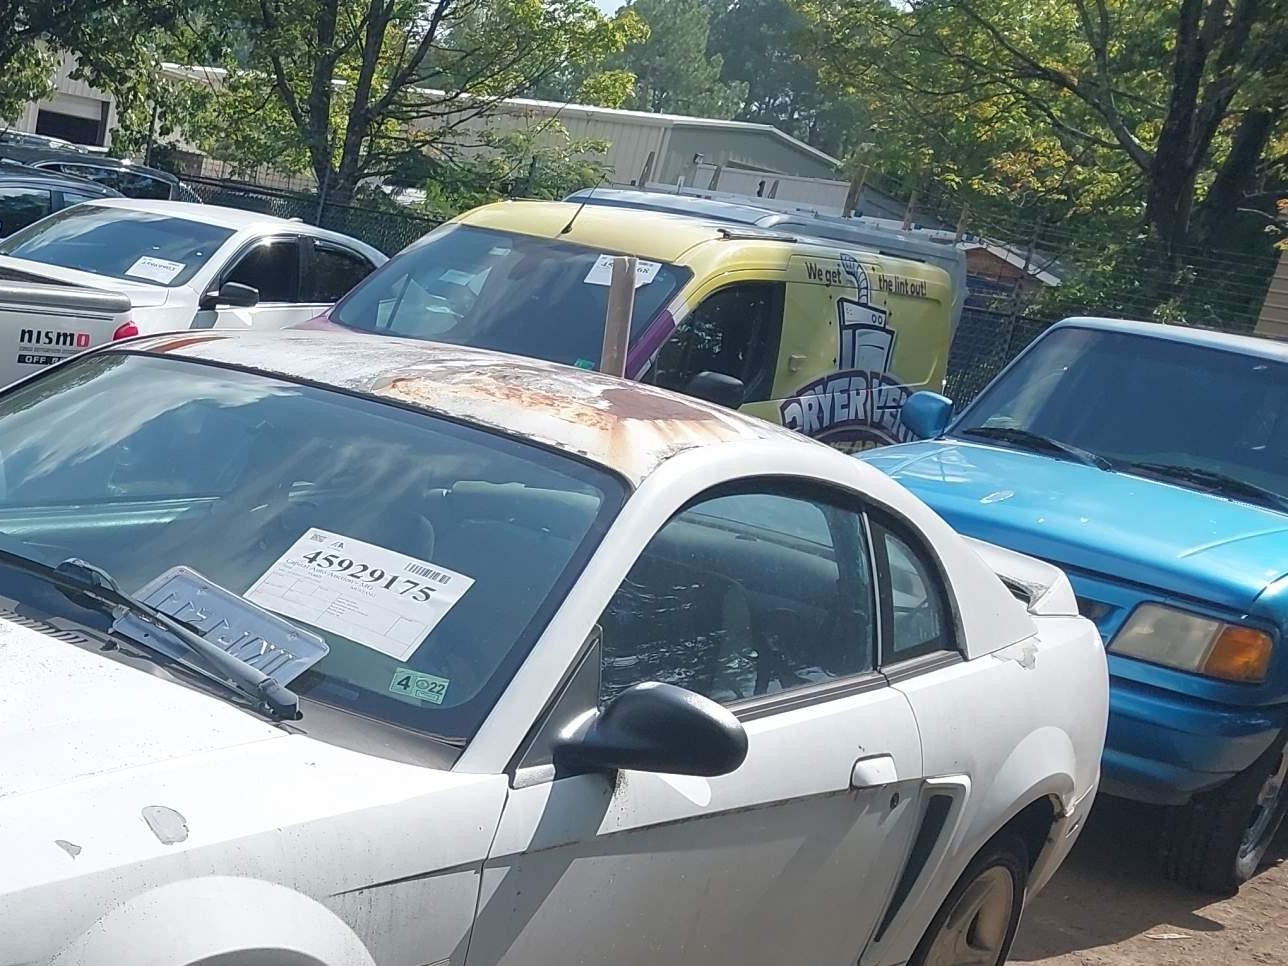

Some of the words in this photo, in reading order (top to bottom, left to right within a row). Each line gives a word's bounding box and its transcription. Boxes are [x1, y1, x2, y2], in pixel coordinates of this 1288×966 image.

[804, 261, 823, 281] We
[825, 263, 842, 287] get
[878, 274, 894, 292] the
[895, 275, 909, 294] lint
[910, 278, 927, 297] out!
[25, 355, 46, 364] OFF
[783, 376, 868, 433] DRYER
[303, 550, 437, 602] 45929175
[397, 675, 411, 690] 4
[428, 681, 445, 696] 22
